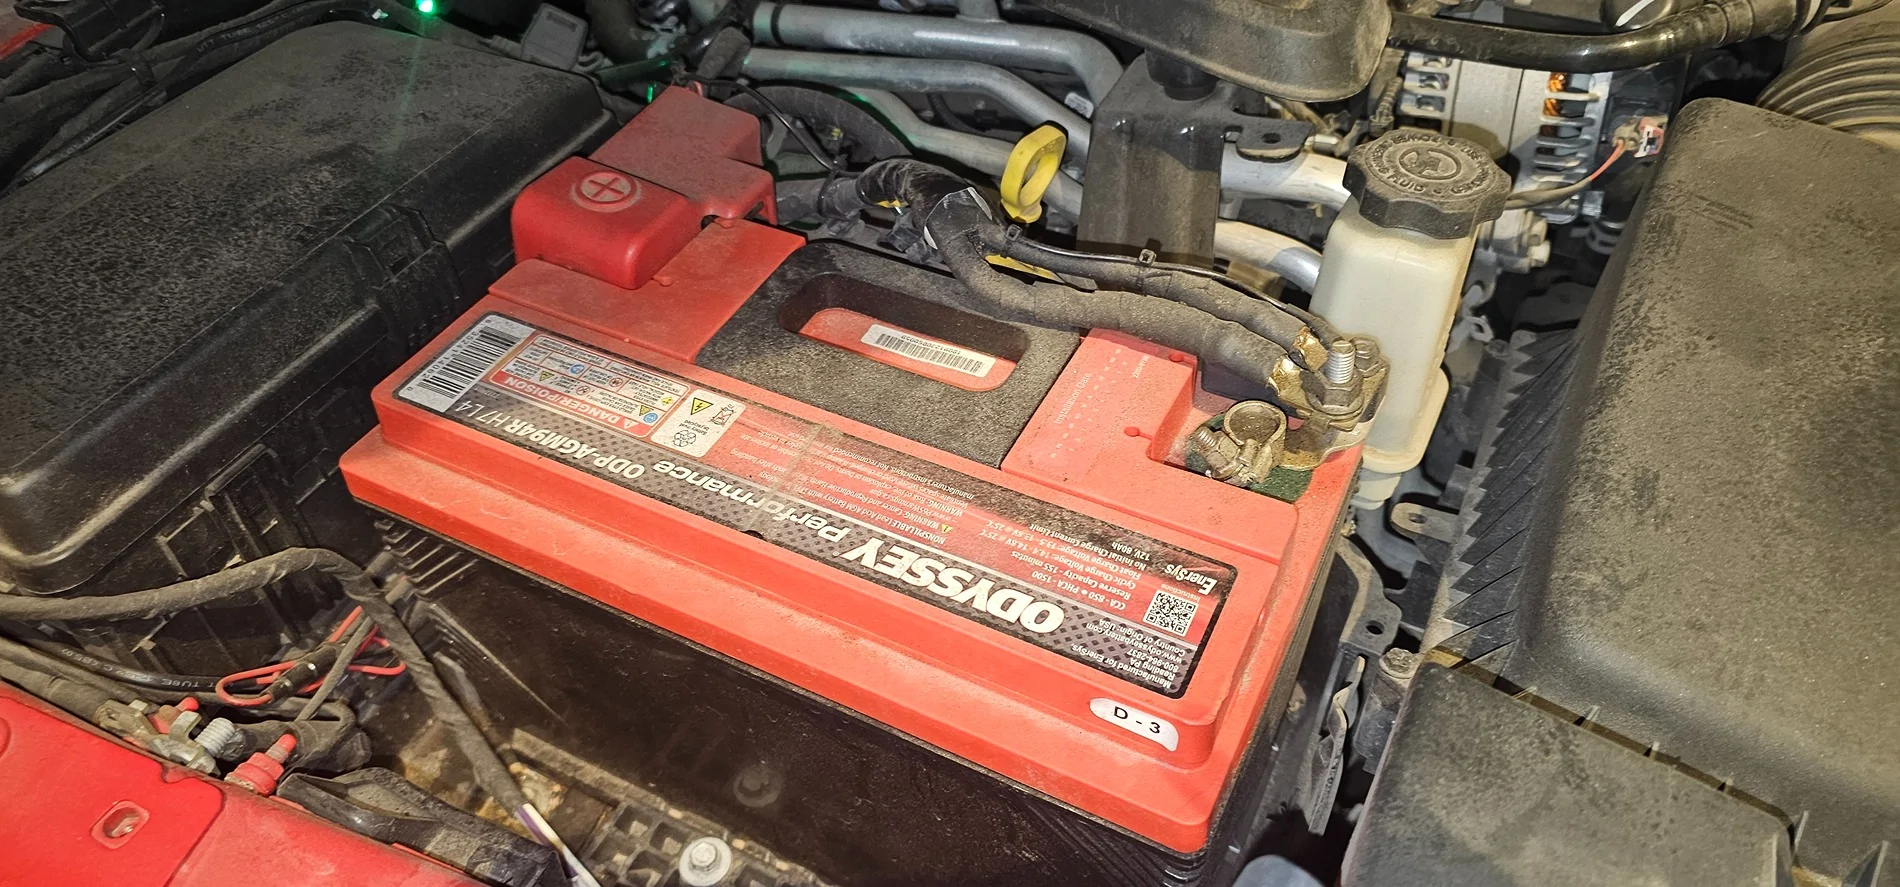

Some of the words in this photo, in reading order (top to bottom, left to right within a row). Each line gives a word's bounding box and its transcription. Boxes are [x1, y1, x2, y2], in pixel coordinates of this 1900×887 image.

[1387, 174, 1425, 192] FLUID
[502, 376, 621, 424] DANGER/POISON
[1053, 384, 1082, 424] Installation
[1076, 373, 1092, 389] Date
[455, 400, 486, 417] L4
[476, 410, 511, 427] H7
[504, 418, 645, 479] ODP-AGM94R
[653, 460, 850, 543] Performance
[820, 492, 848, 508] Battery
[910, 493, 927, 504] Risk
[924, 497, 964, 517] WARNING:
[844, 502, 862, 513] AGM
[859, 507, 878, 519] Acid
[879, 501, 904, 516] Cancer
[874, 513, 893, 525] Lead
[889, 519, 946, 545] NONSPILLABLE
[1026, 522, 1051, 536] Limit
[1048, 530, 1081, 547] Current
[1077, 539, 1110, 557] Charge
[1109, 540, 1133, 555] 80Ah
[1131, 547, 1152, 561] 12V,
[1008, 549, 1044, 568] minutes
[1088, 554, 1121, 573] Charge
[1106, 551, 1134, 566] Initial
[1132, 560, 1147, 571] No
[1030, 569, 1052, 583] 1500
[1041, 561, 1059, 574] 155
[1082, 563, 1115, 582] Charge
[1117, 565, 1142, 580] Float
[840, 537, 1065, 633] ODYSSEY
[1054, 578, 1080, 594] PHCA
[1061, 568, 1100, 589] Capacity
[1111, 573, 1138, 590] Cyclic
[1164, 564, 1218, 596] EnerSys
[1086, 590, 1106, 603] 850
[1096, 581, 1132, 601] Reserve
[1158, 582, 1201, 602] Instructions
[1107, 598, 1127, 611] CCA
[1096, 618, 1116, 630] USA
[1115, 623, 1144, 641] Origin:
[1084, 620, 1184, 664] www.odysseybattery.com
[1153, 638, 1187, 657] Country
[1125, 646, 1179, 673] 800-964-2837
[1127, 656, 1142, 668] PA
[1115, 661, 1172, 689] Manufactured
[1140, 660, 1176, 681] Reading
[161, 678, 200, 688] TUBE
[1114, 706, 1128, 720] D
[1149, 722, 1160, 734] 3
